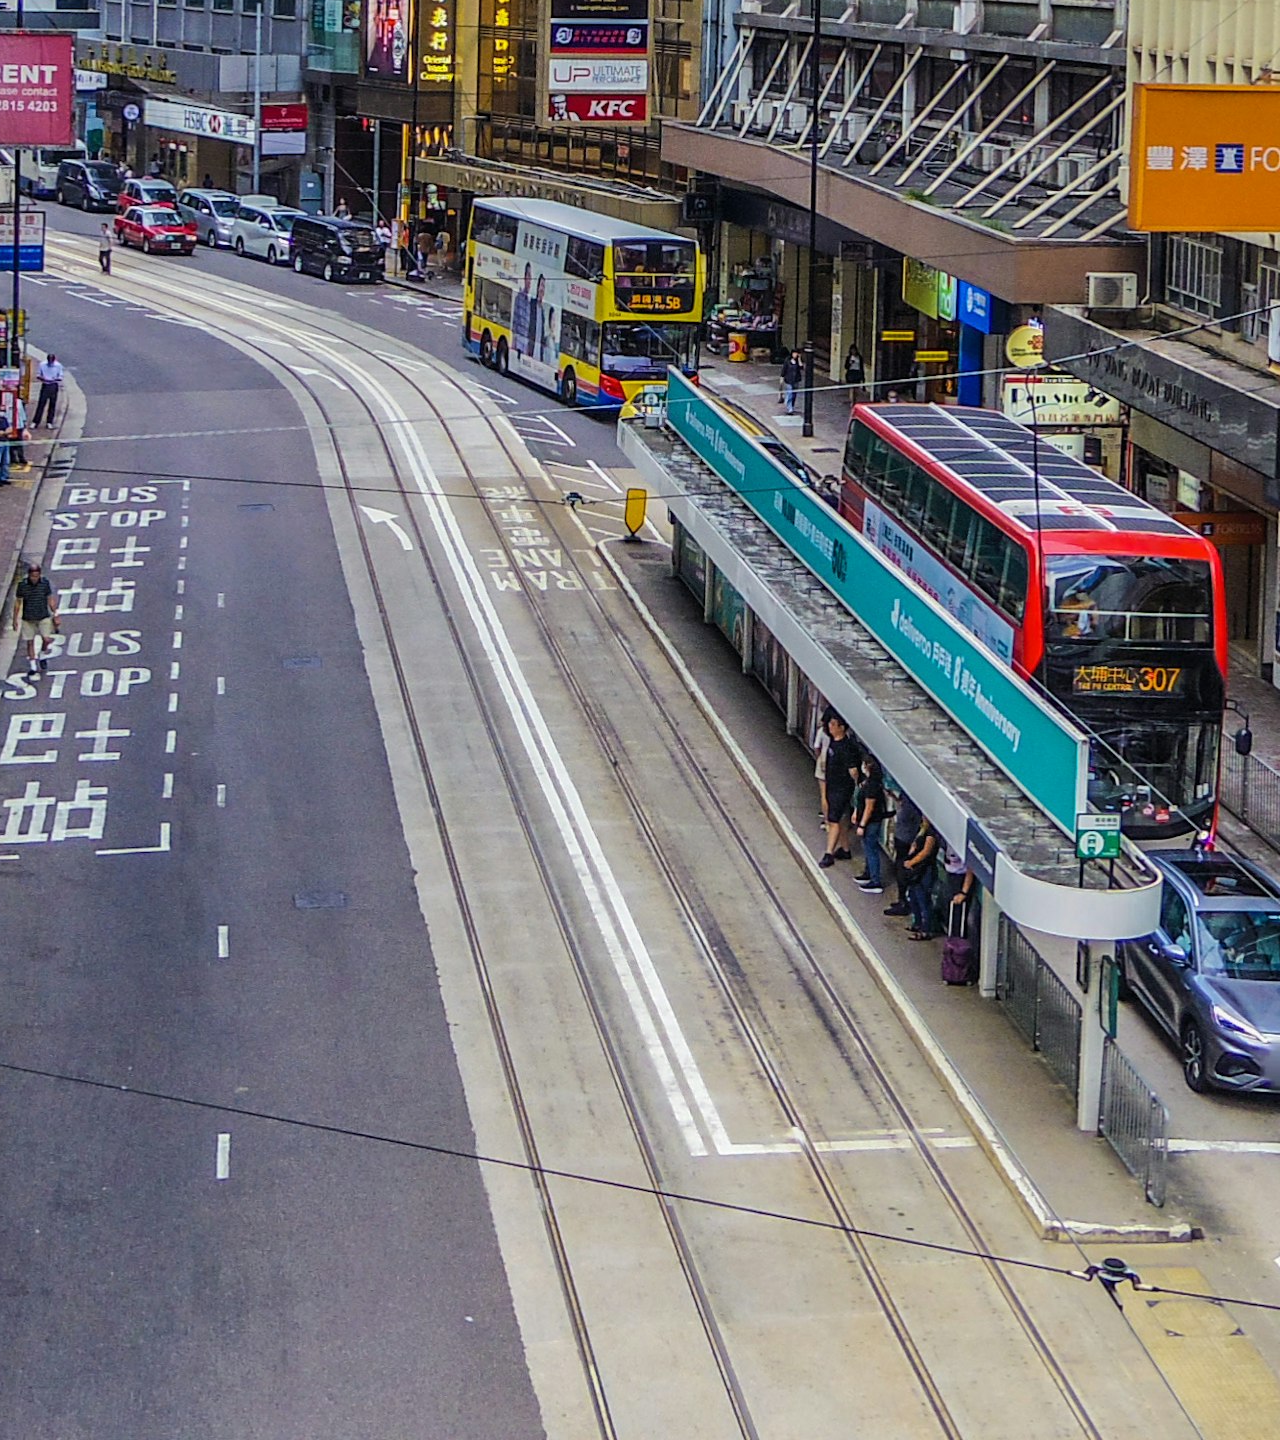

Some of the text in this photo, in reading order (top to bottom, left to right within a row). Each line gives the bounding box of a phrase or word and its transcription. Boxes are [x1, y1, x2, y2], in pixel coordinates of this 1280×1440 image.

[554, 65, 591, 83] UP
[592, 65, 641, 76] ULTIMATE
[21, 87, 58, 97] contact
[27, 101, 58, 112] 4203
[587, 100, 636, 117] KFC
[184, 109, 207, 133] HSBC
[1146, 146, 1208, 171] 豐澤
[665, 295, 682, 310] 5B
[68, 486, 158, 505] BUS
[52, 509, 167, 531] STOP
[50, 535, 151, 571] 巴士
[479, 548, 601, 568] LANE
[490, 570, 618, 591] TRAM
[56, 576, 136, 615] 站
[39, 629, 142, 659] BUS
[3, 667, 152, 700] STOP
[899, 609, 931, 659] deliveroo
[975, 682, 1021, 753] Anniversary
[1074, 665, 1181, 692] 大埔中心 307
